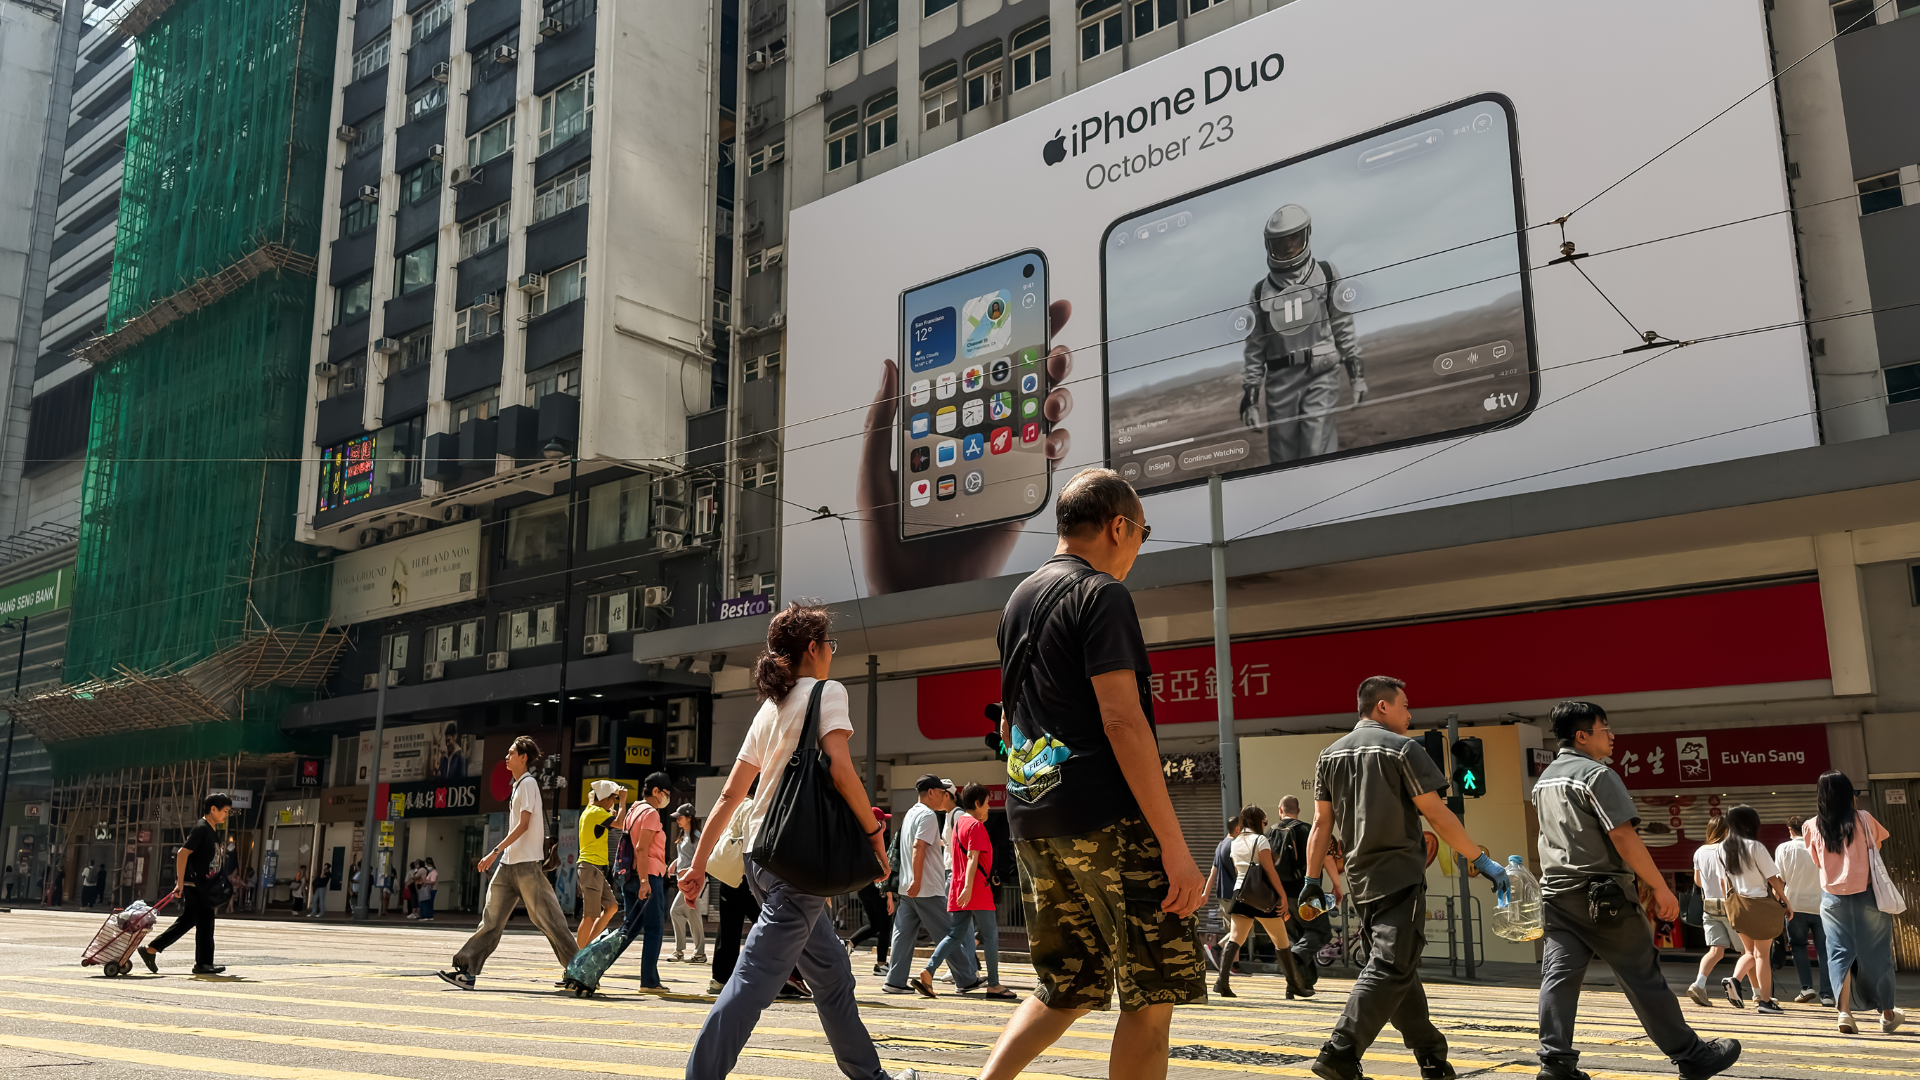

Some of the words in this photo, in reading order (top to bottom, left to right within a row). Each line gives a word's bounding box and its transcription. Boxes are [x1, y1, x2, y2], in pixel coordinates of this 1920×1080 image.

[1071, 87, 1195, 158] iPhone
[1204, 53, 1285, 106] Duo
[1453, 125, 1470, 136] 9:41
[1085, 135, 1191, 190] October
[1198, 114, 1234, 151] 23
[923, 315, 945, 325] Francisco
[915, 326, 932, 342] 12°
[1498, 392, 1519, 408] tv
[1118, 436, 1132, 445] Silo
[1124, 468, 1136, 476] Info
[1148, 461, 1171, 471] InSight
[1183, 452, 1213, 465] Continue
[1212, 446, 1245, 459] Watching
[411, 554, 430, 569] HERE
[432, 550, 450, 563] AND
[451, 546, 471, 558] NOW
[336, 573, 355, 588] YOGA
[356, 565, 387, 582] GROUND
[0, 598, 16, 615] HANG
[16, 592, 35, 610] SENG
[35, 585, 55, 604] BANK
[720, 600, 765, 620] Bestco
[628, 747, 650, 757] 1010
[1721, 751, 1740, 765] Eu
[1740, 750, 1766, 763] Yan
[1768, 749, 1806, 765] Sang
[1029, 753, 1048, 771] FIELD
[301, 776, 318, 785] DBS
[447, 785, 476, 808] DBS
